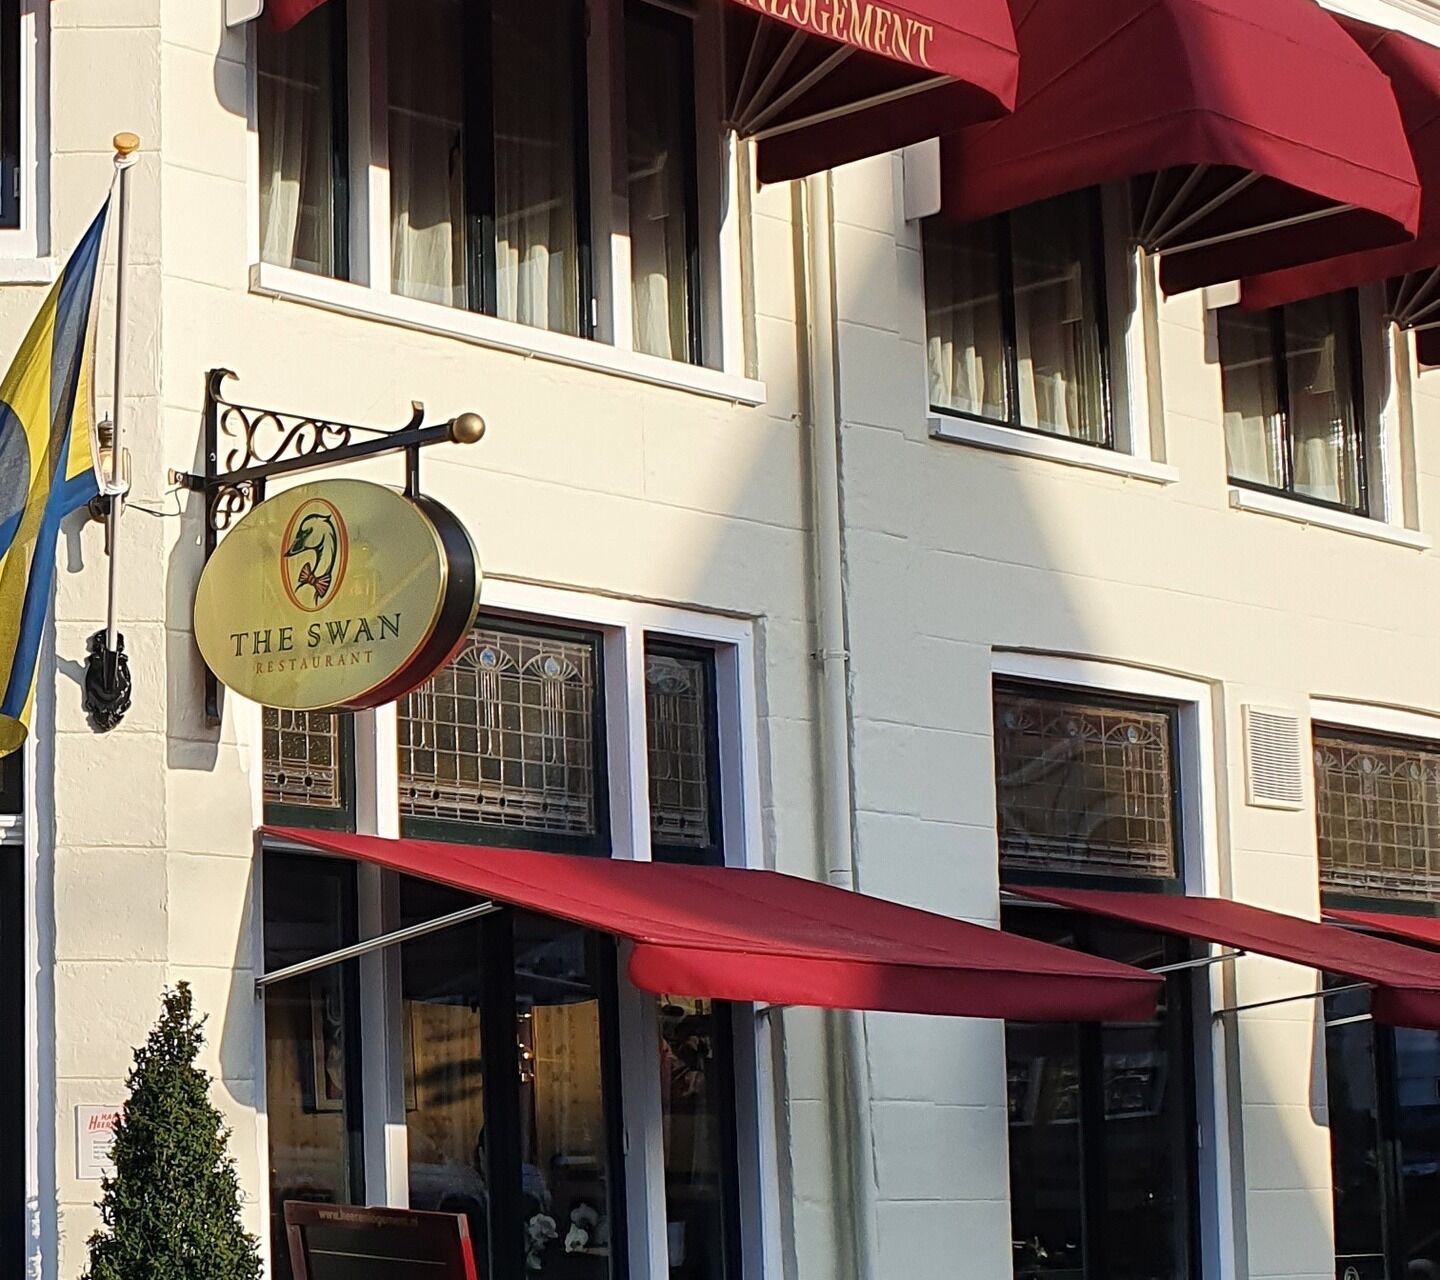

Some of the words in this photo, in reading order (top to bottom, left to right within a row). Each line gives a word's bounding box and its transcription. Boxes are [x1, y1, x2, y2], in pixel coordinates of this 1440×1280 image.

[230, 626, 294, 657] THE
[307, 613, 402, 648] SWAN
[256, 650, 374, 675] RESTAURANT
